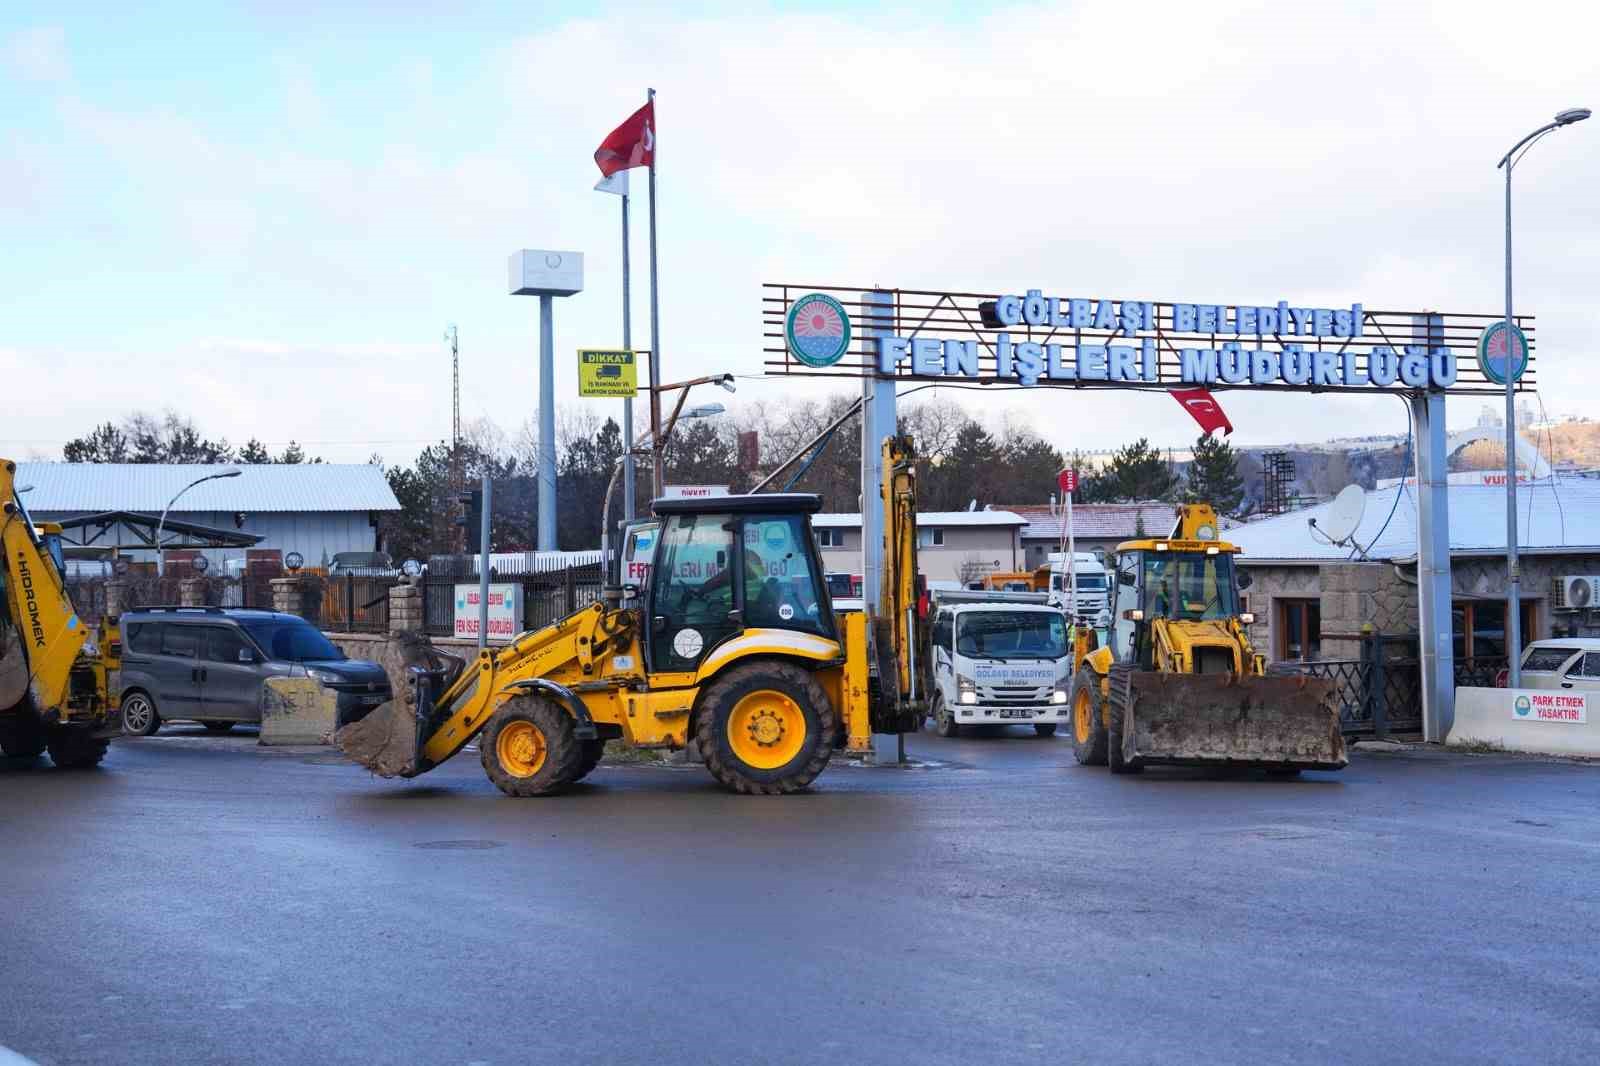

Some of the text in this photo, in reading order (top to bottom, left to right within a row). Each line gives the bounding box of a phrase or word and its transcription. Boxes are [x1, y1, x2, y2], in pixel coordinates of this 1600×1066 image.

[995, 289, 1363, 338] GÖLBAŞI BELEDİYESİ
[587, 353, 629, 363] DİKKAT
[878, 332, 1458, 388] FEN İŞLERİ MÜDÜRLÜĞÜ
[1532, 695, 1584, 708] PARK ETMEK
